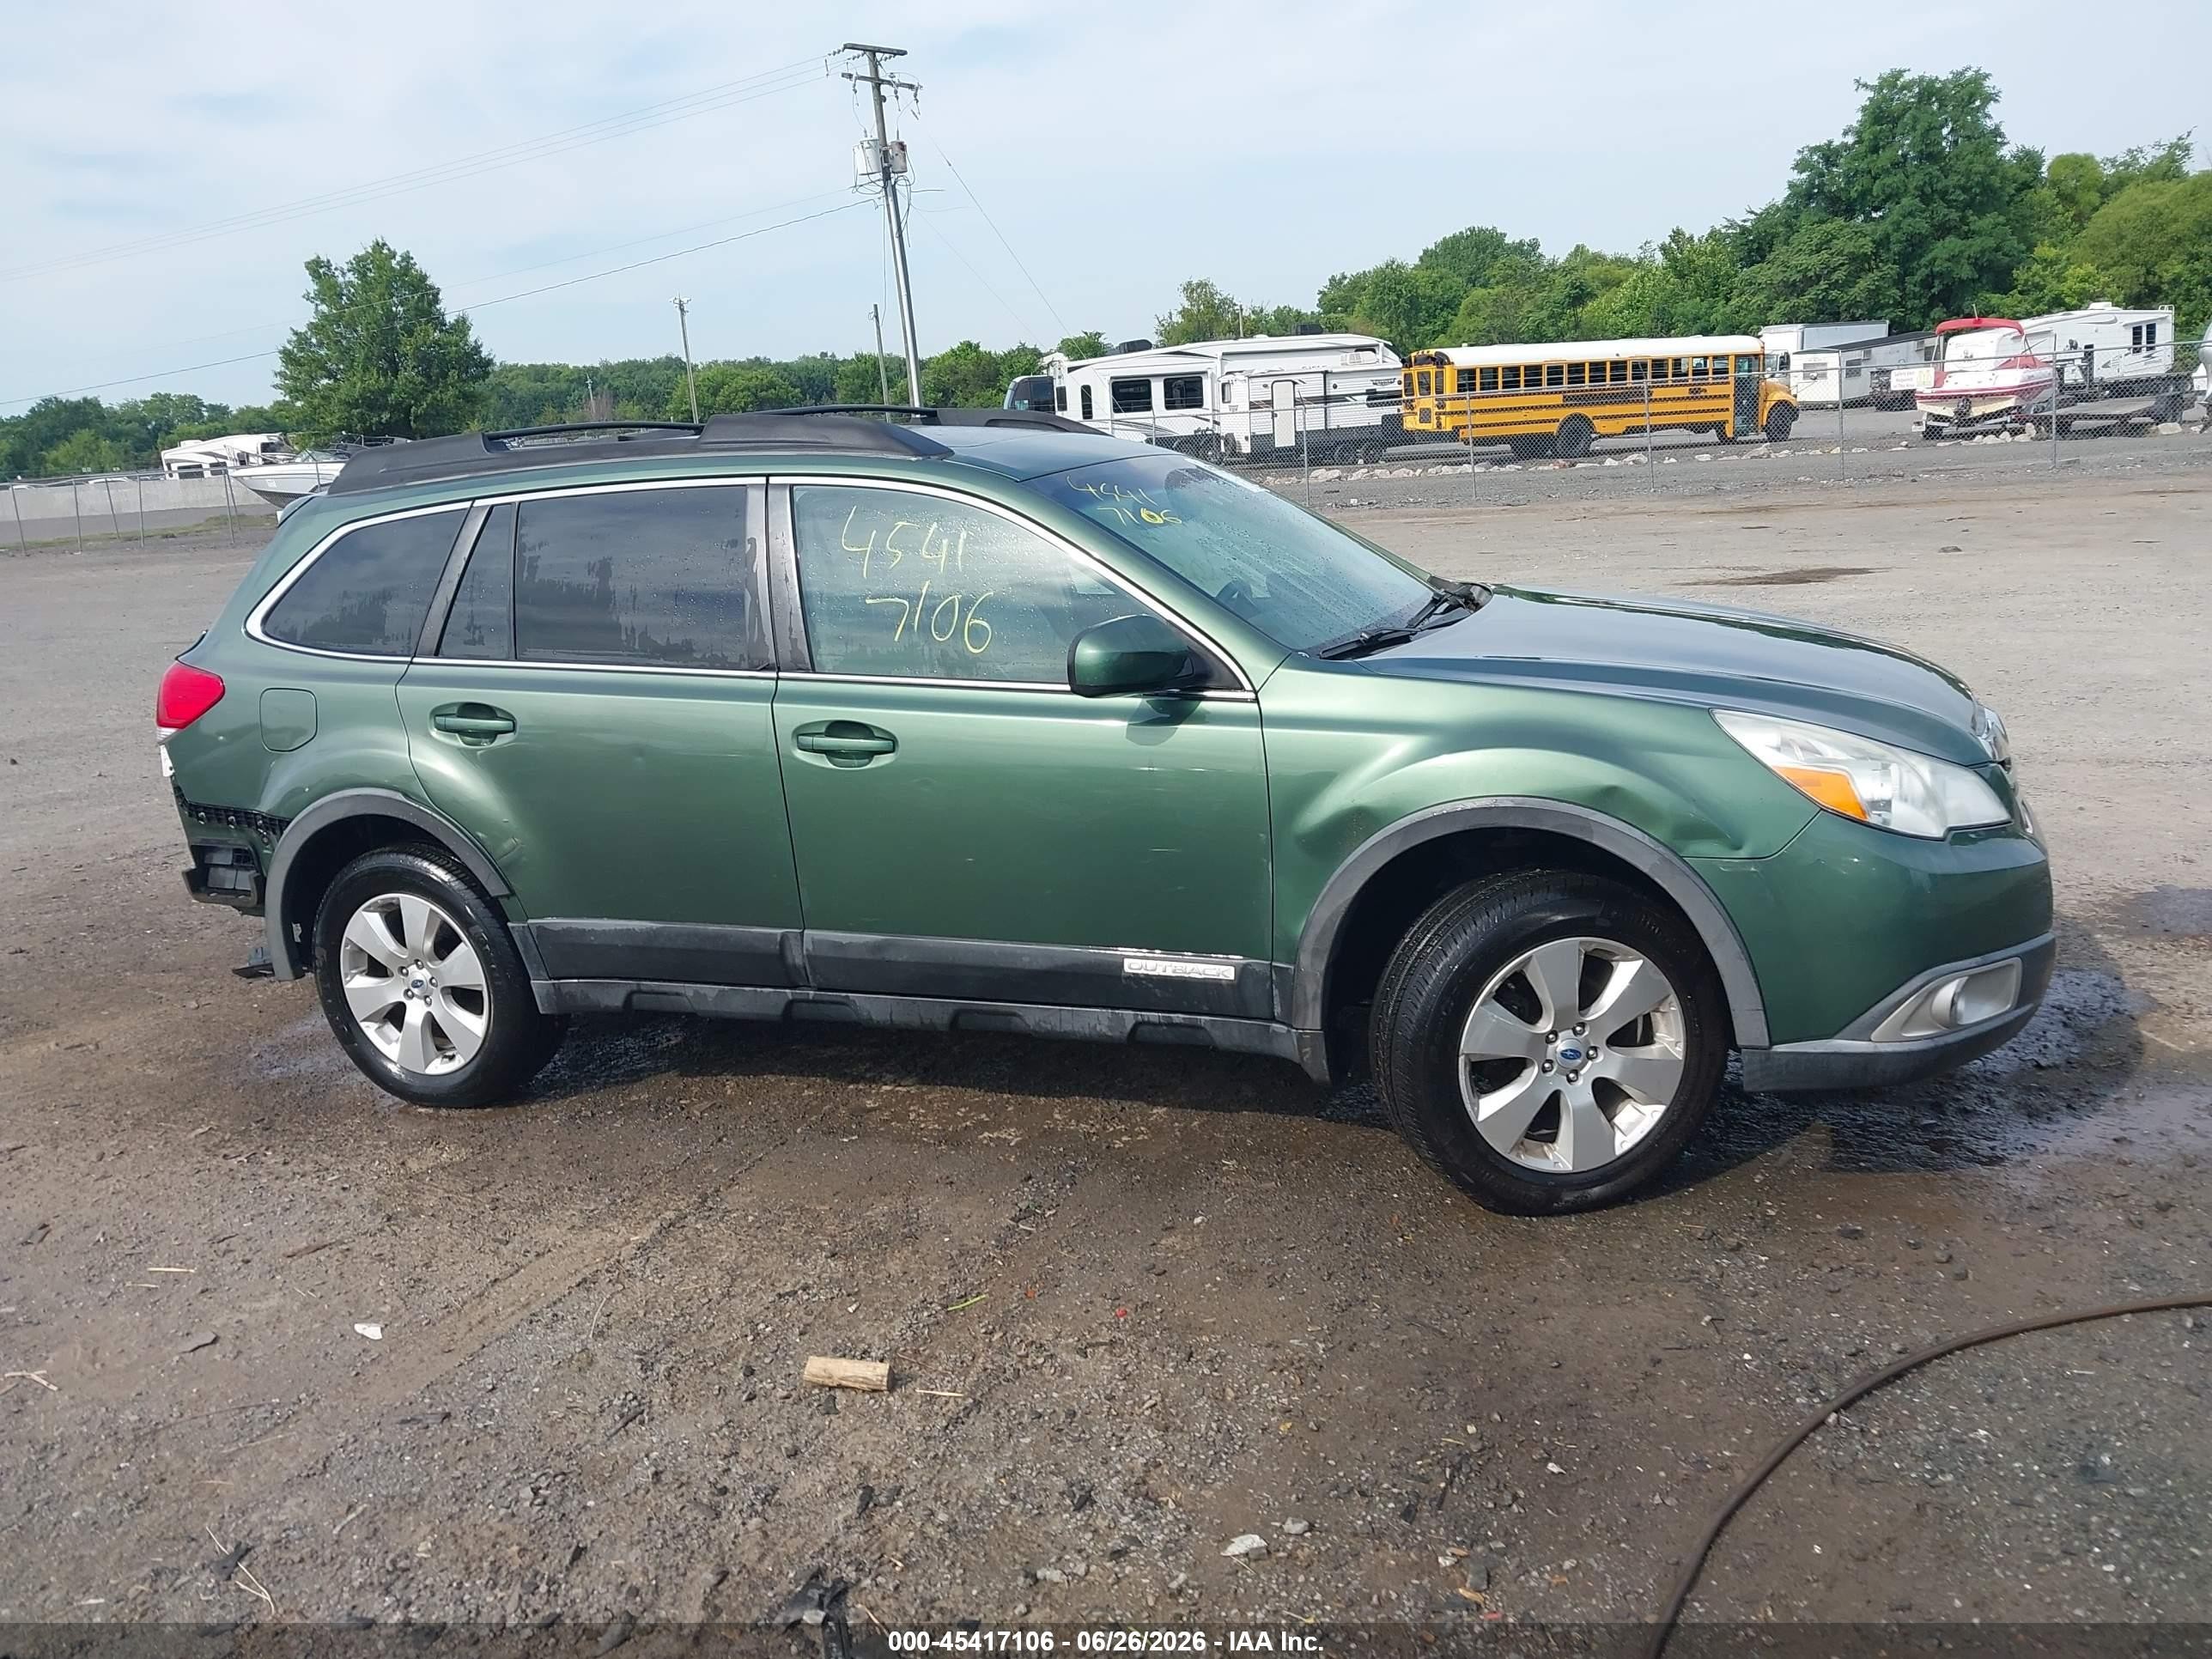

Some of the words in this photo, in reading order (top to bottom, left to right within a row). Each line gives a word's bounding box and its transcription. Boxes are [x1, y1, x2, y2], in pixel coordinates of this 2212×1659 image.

[1066, 474, 1158, 507] 4541
[1097, 507, 1182, 526] 7106
[842, 505, 968, 579] 4541
[864, 580, 995, 654] 7106
[1127, 961, 1231, 978] OUTBACK
